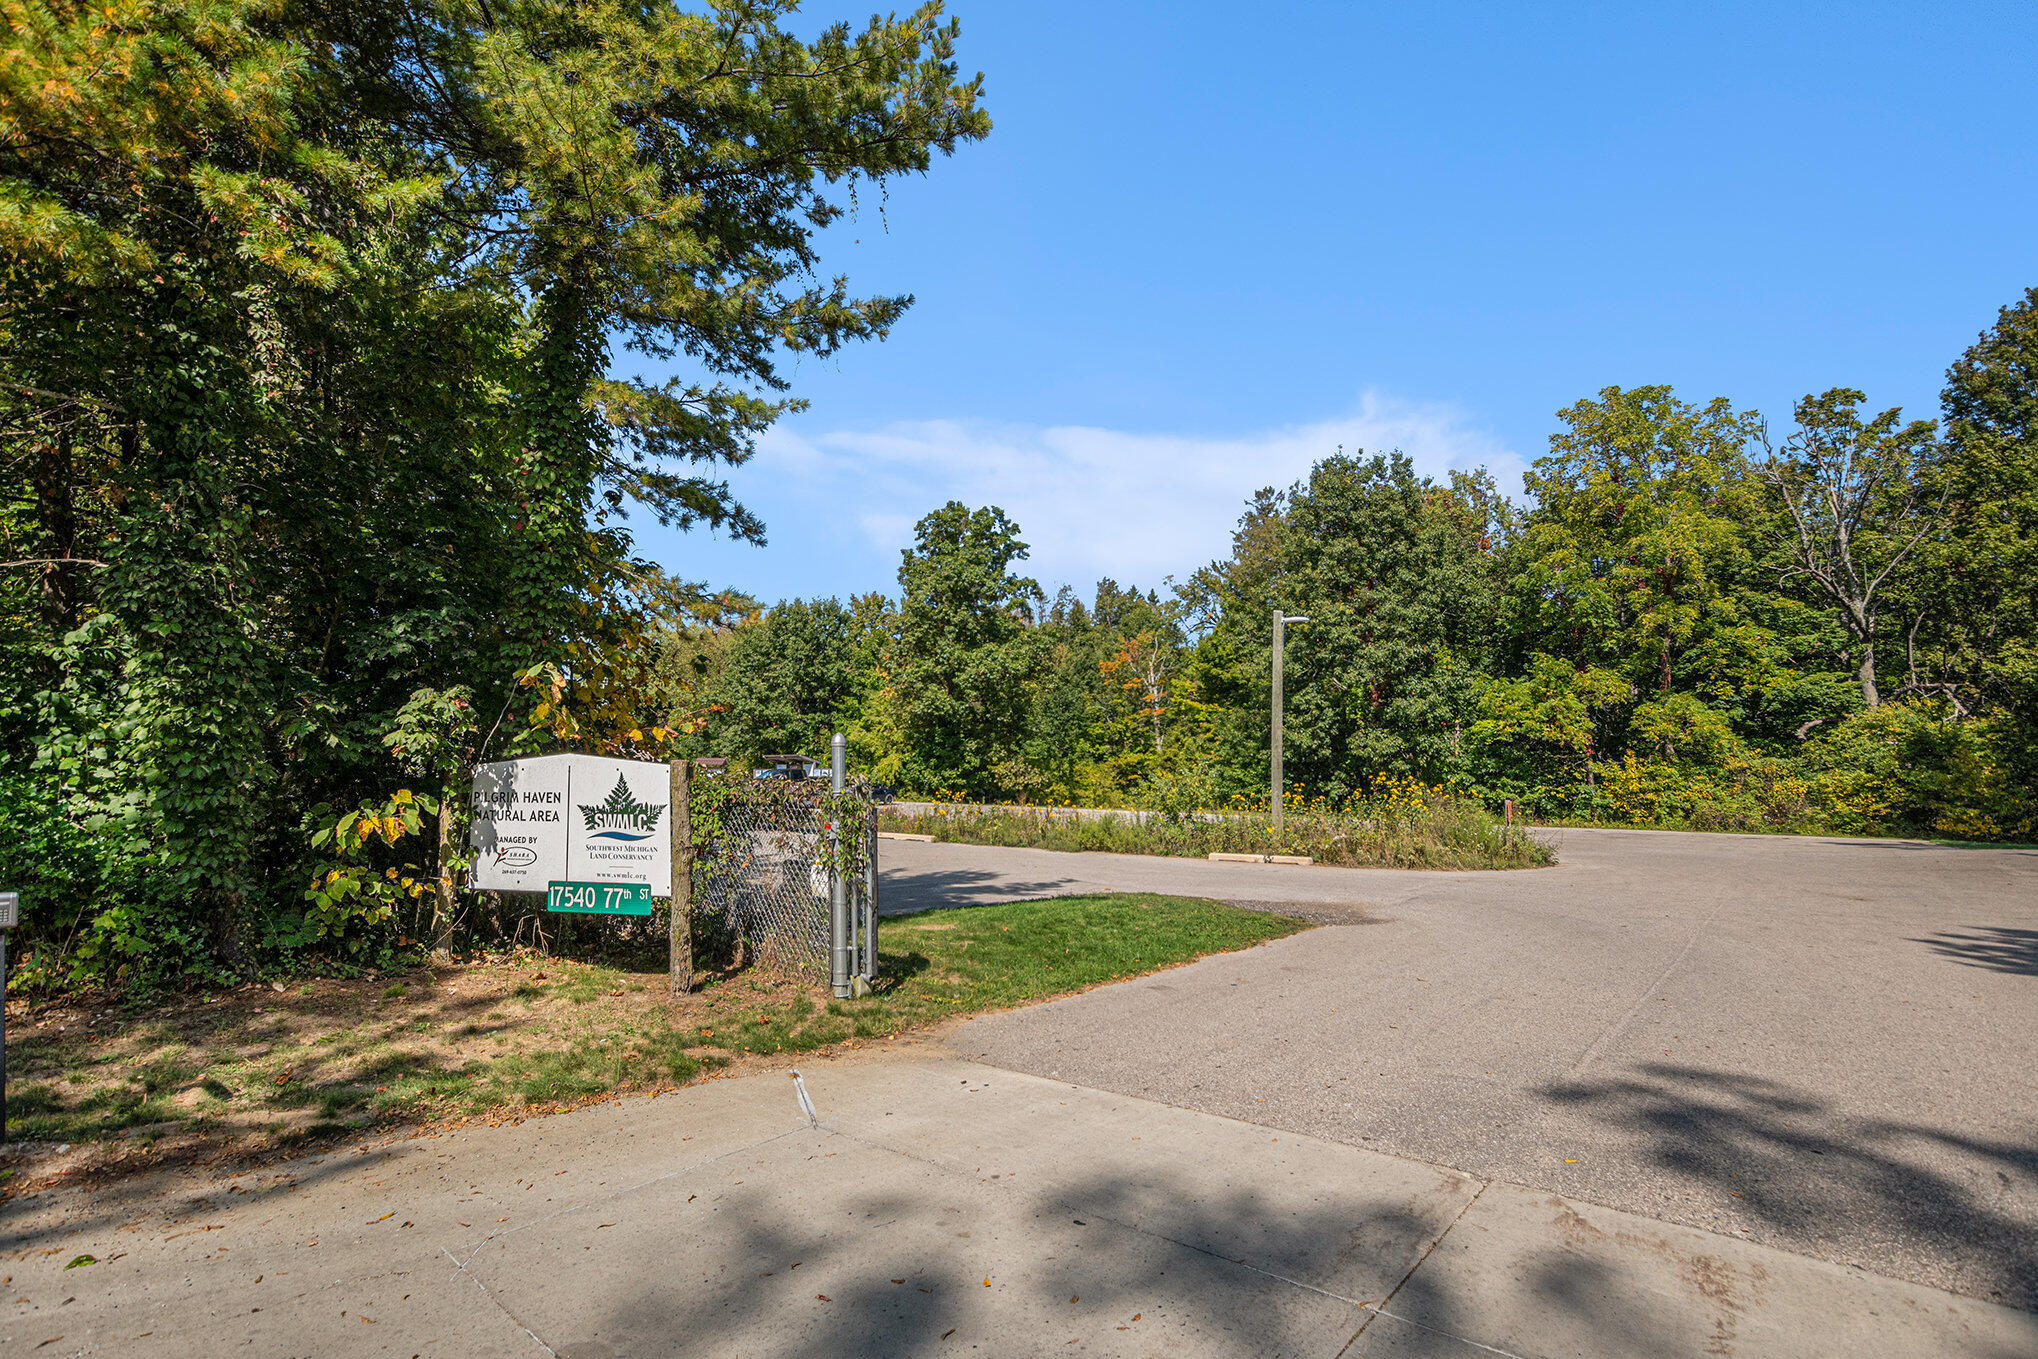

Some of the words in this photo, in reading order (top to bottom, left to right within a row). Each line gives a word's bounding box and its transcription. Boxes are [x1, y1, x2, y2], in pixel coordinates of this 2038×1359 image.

[474, 791, 518, 803] PILGRIM
[523, 792, 561, 803] HAVEN
[474, 810, 526, 822] NATURAL
[529, 810, 560, 822] AREA
[594, 813, 648, 832] SWMLC
[528, 836, 538, 844] BY
[596, 871, 647, 881] www.swmlc.org
[549, 886, 596, 908] 17540
[603, 887, 632, 909] 77th
[639, 888, 650, 900] ST
